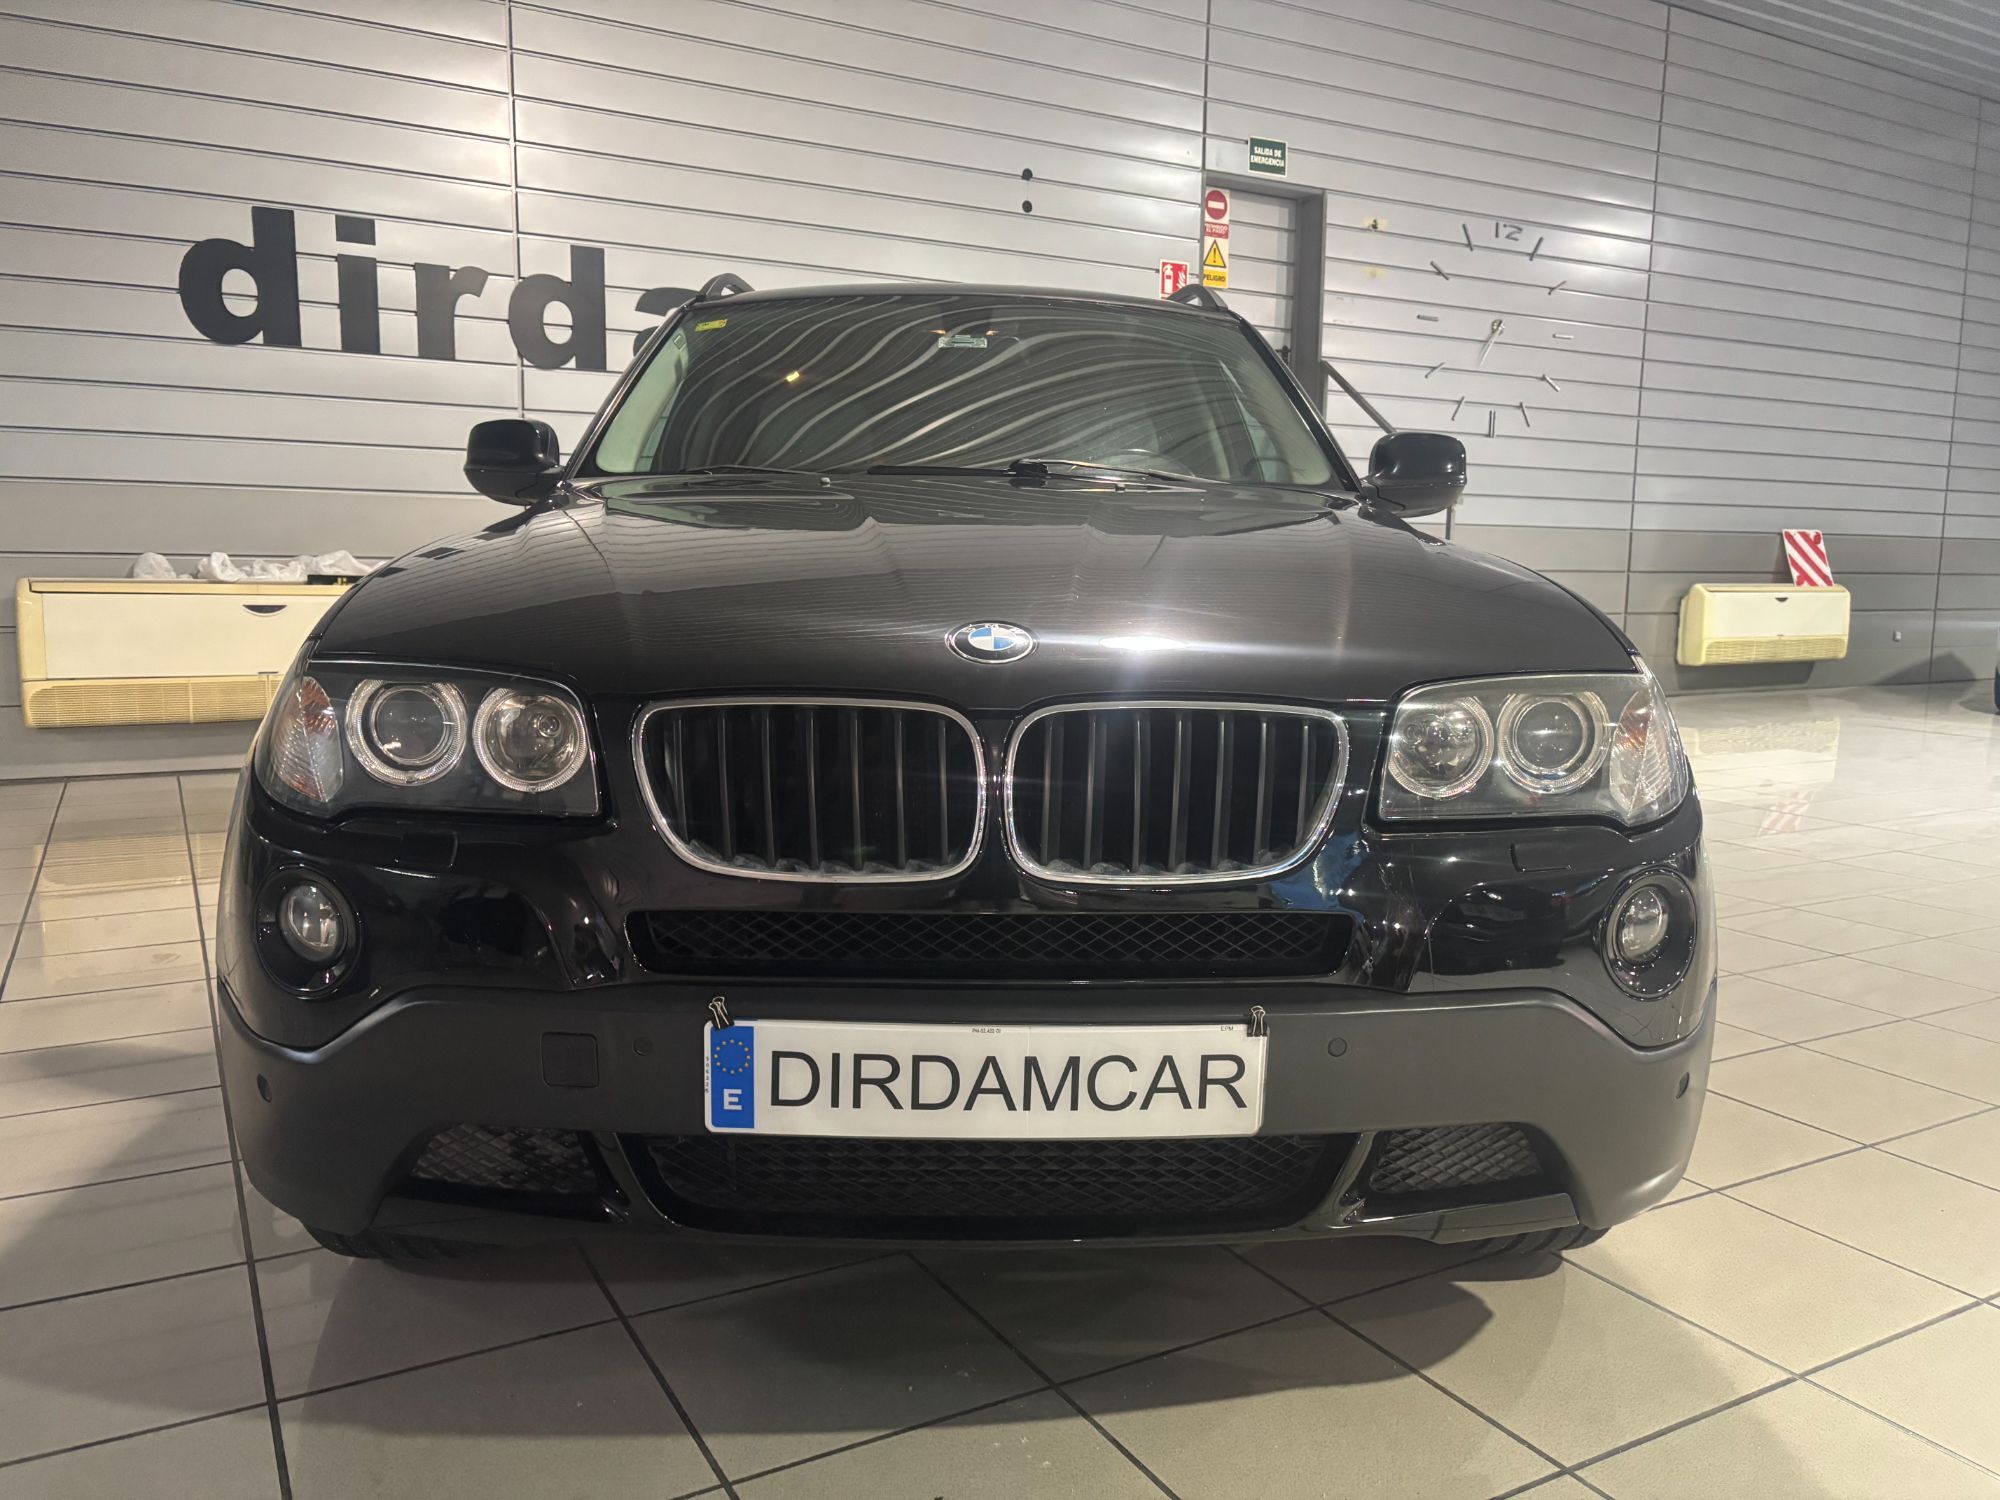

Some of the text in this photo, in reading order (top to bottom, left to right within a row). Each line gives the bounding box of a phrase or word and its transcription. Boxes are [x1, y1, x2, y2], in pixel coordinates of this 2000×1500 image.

[1251, 155, 1284, 167] EMERGENCIA
[1254, 146, 1282, 158] SALIDA DE
[1495, 221, 1523, 241] 12
[770, 1050, 1248, 1111] DIRDAMCAR
[723, 1088, 742, 1110] E
